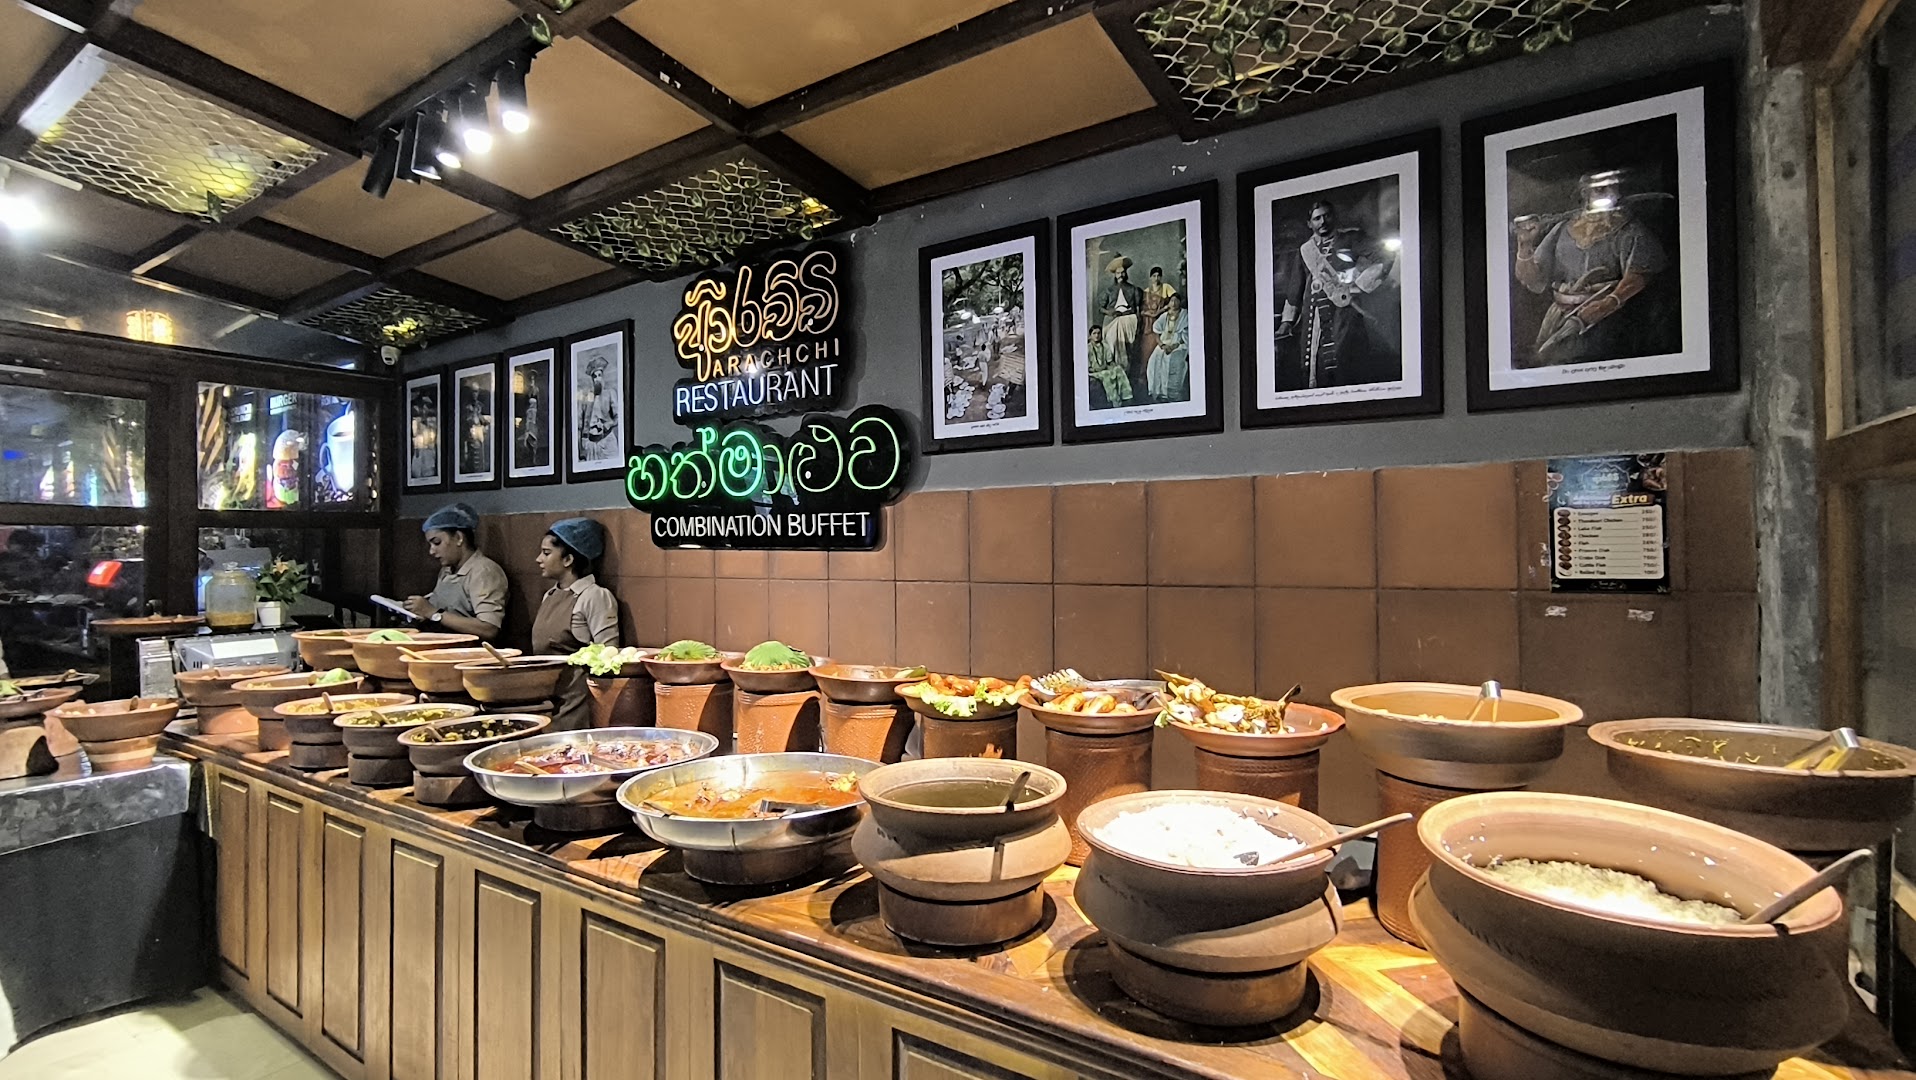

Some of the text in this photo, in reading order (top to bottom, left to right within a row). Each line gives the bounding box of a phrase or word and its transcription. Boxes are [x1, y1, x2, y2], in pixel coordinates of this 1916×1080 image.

[712, 338, 840, 378] ARACHCHI
[676, 364, 838, 416] RESTAURANT
[1611, 495, 1648, 504] Extra
[655, 512, 870, 538] COMBINATION BUFFET
